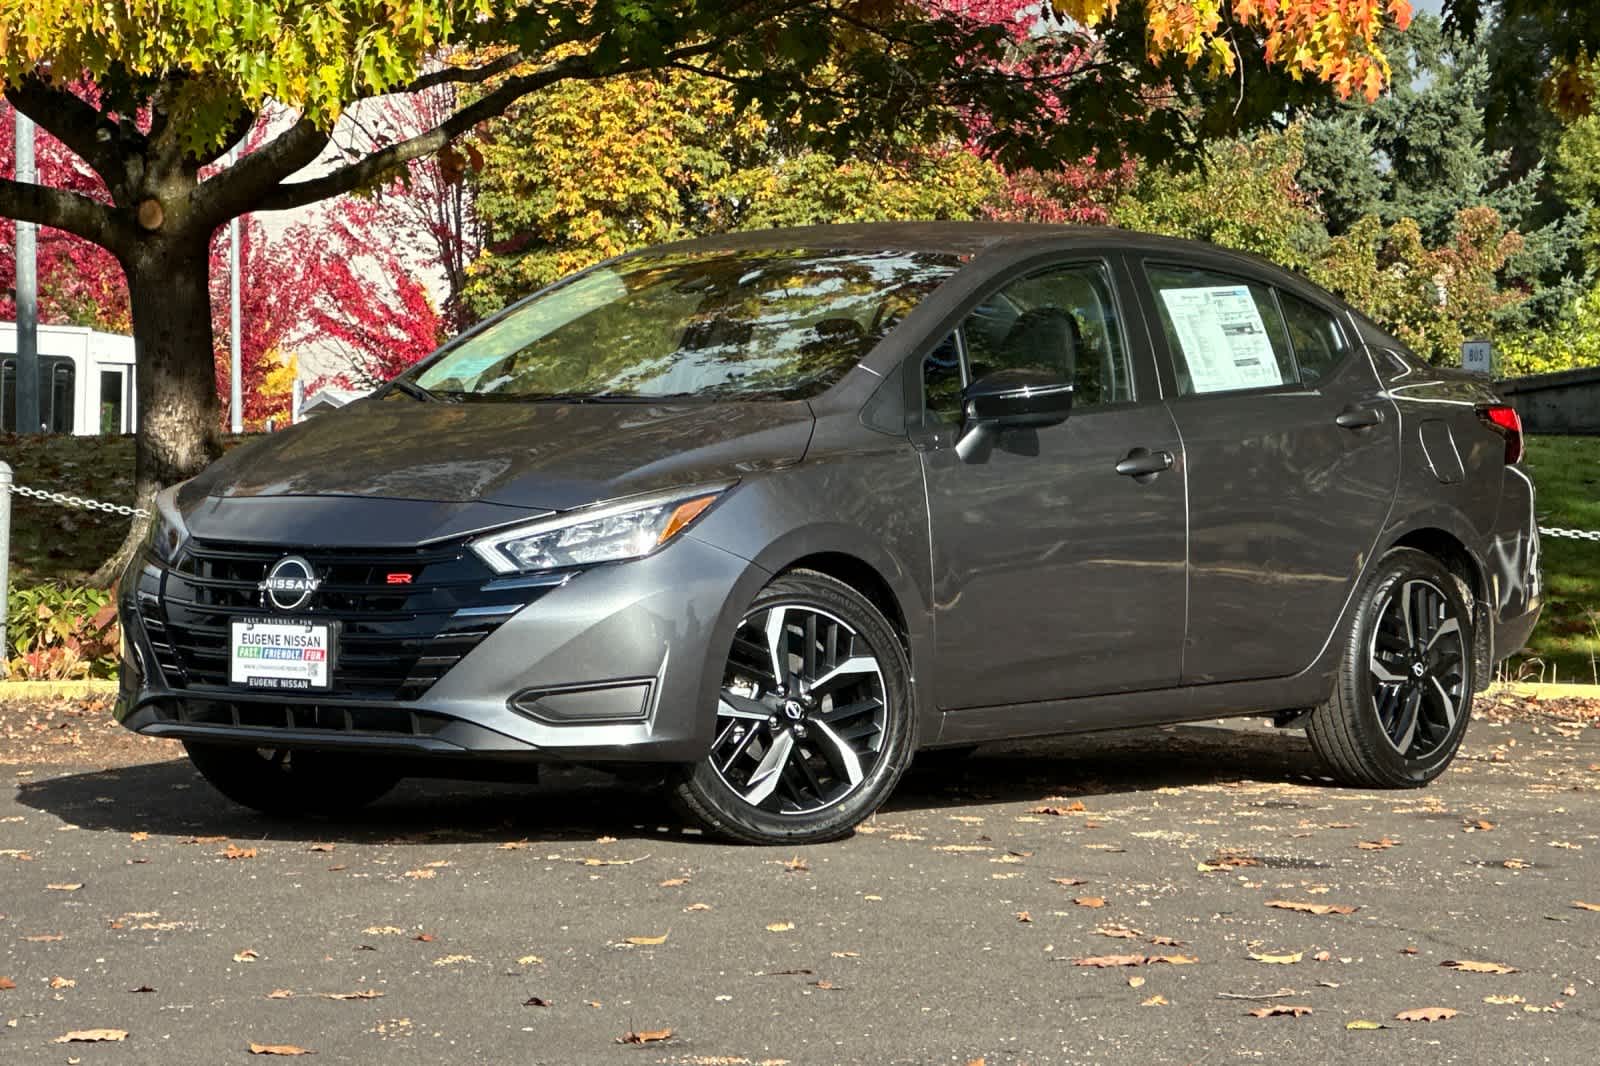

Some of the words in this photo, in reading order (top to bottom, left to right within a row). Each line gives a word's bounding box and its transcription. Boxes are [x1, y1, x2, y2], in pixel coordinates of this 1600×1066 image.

[265, 578, 316, 591] NISSAN
[387, 573, 412, 584] SR
[241, 632, 281, 646] EUGENE
[283, 634, 321, 648] NISSAN
[249, 678, 278, 687] EUGENE
[280, 679, 309, 689] NISSAN
